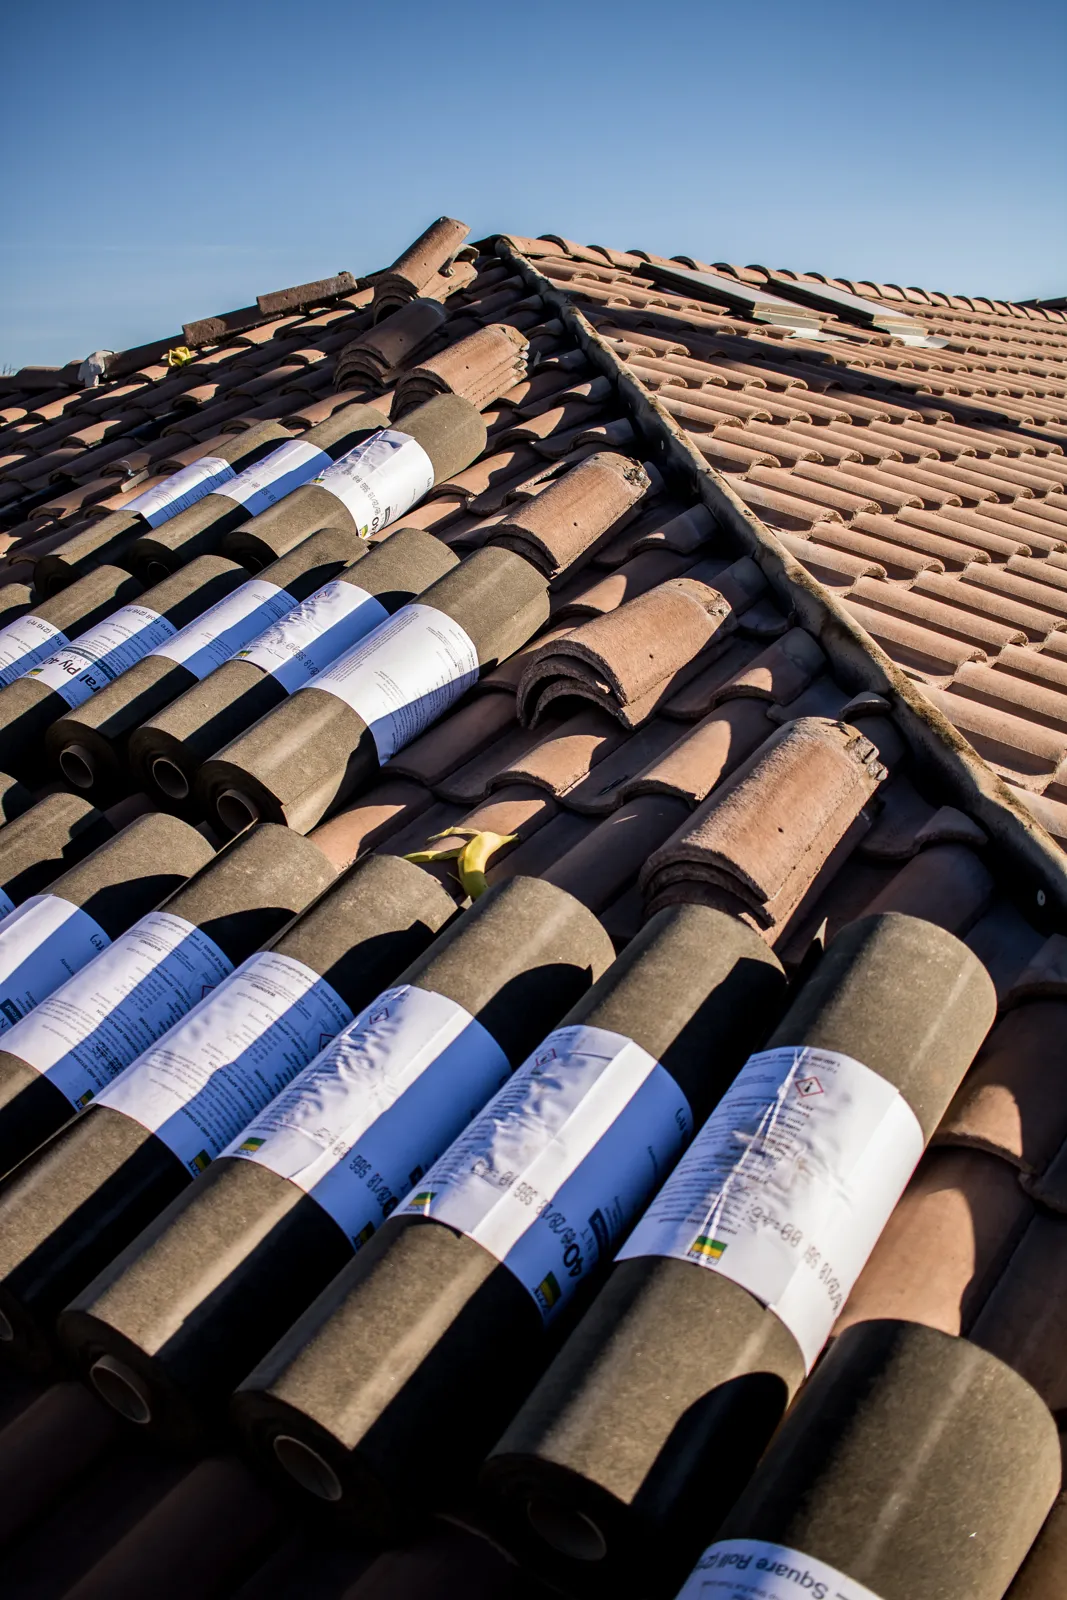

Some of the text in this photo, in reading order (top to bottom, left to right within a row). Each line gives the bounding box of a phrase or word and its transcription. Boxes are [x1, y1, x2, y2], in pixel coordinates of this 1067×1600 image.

[145, 613, 160, 625] Roll
[35, 623, 52, 634] (216
[50, 631, 63, 646] Roll
[57, 659, 81, 676] Ply
[88, 933, 104, 951] ft²)
[562, 1243, 584, 1279] 40
[715, 1554, 752, 1570] Roll
[755, 1558, 828, 1600] Square
